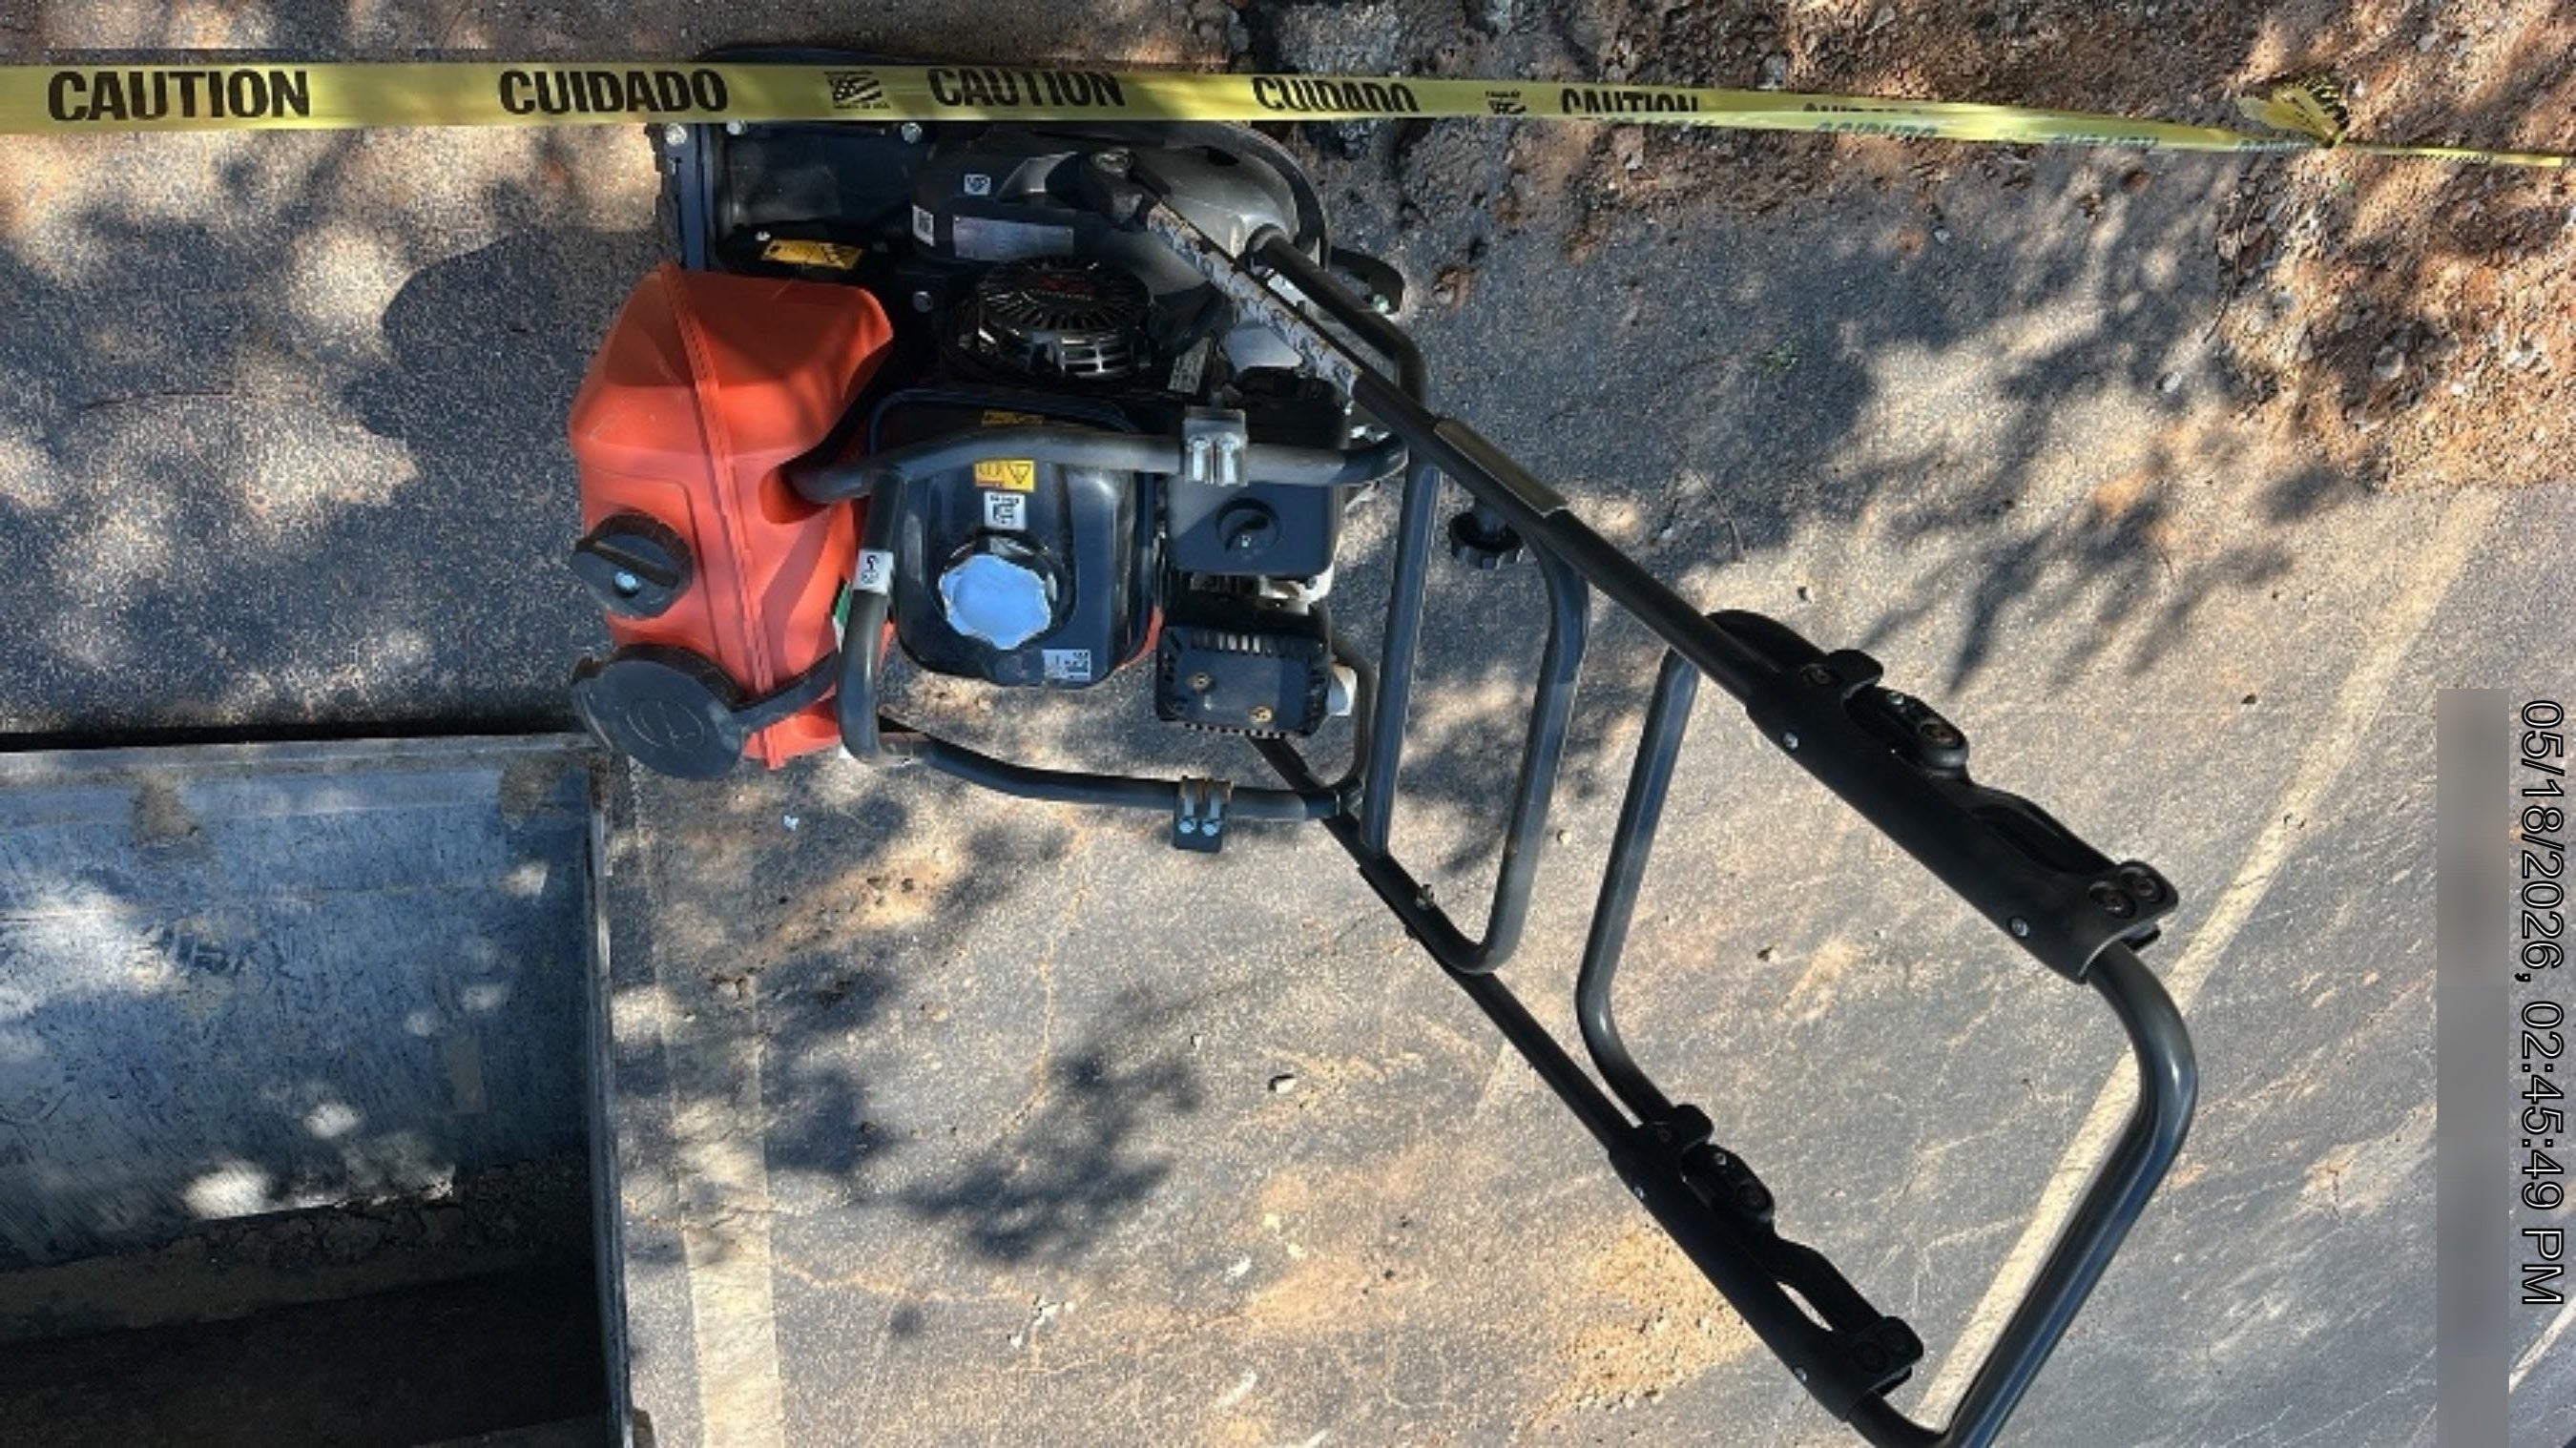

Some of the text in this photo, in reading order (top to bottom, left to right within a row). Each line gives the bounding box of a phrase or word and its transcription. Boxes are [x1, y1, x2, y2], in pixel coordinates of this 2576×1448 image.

[48, 70, 311, 121] CAUTION
[498, 68, 730, 114] CUIDADO
[926, 68, 1126, 107] CAUTION
[1252, 76, 1420, 112] CUIDADO
